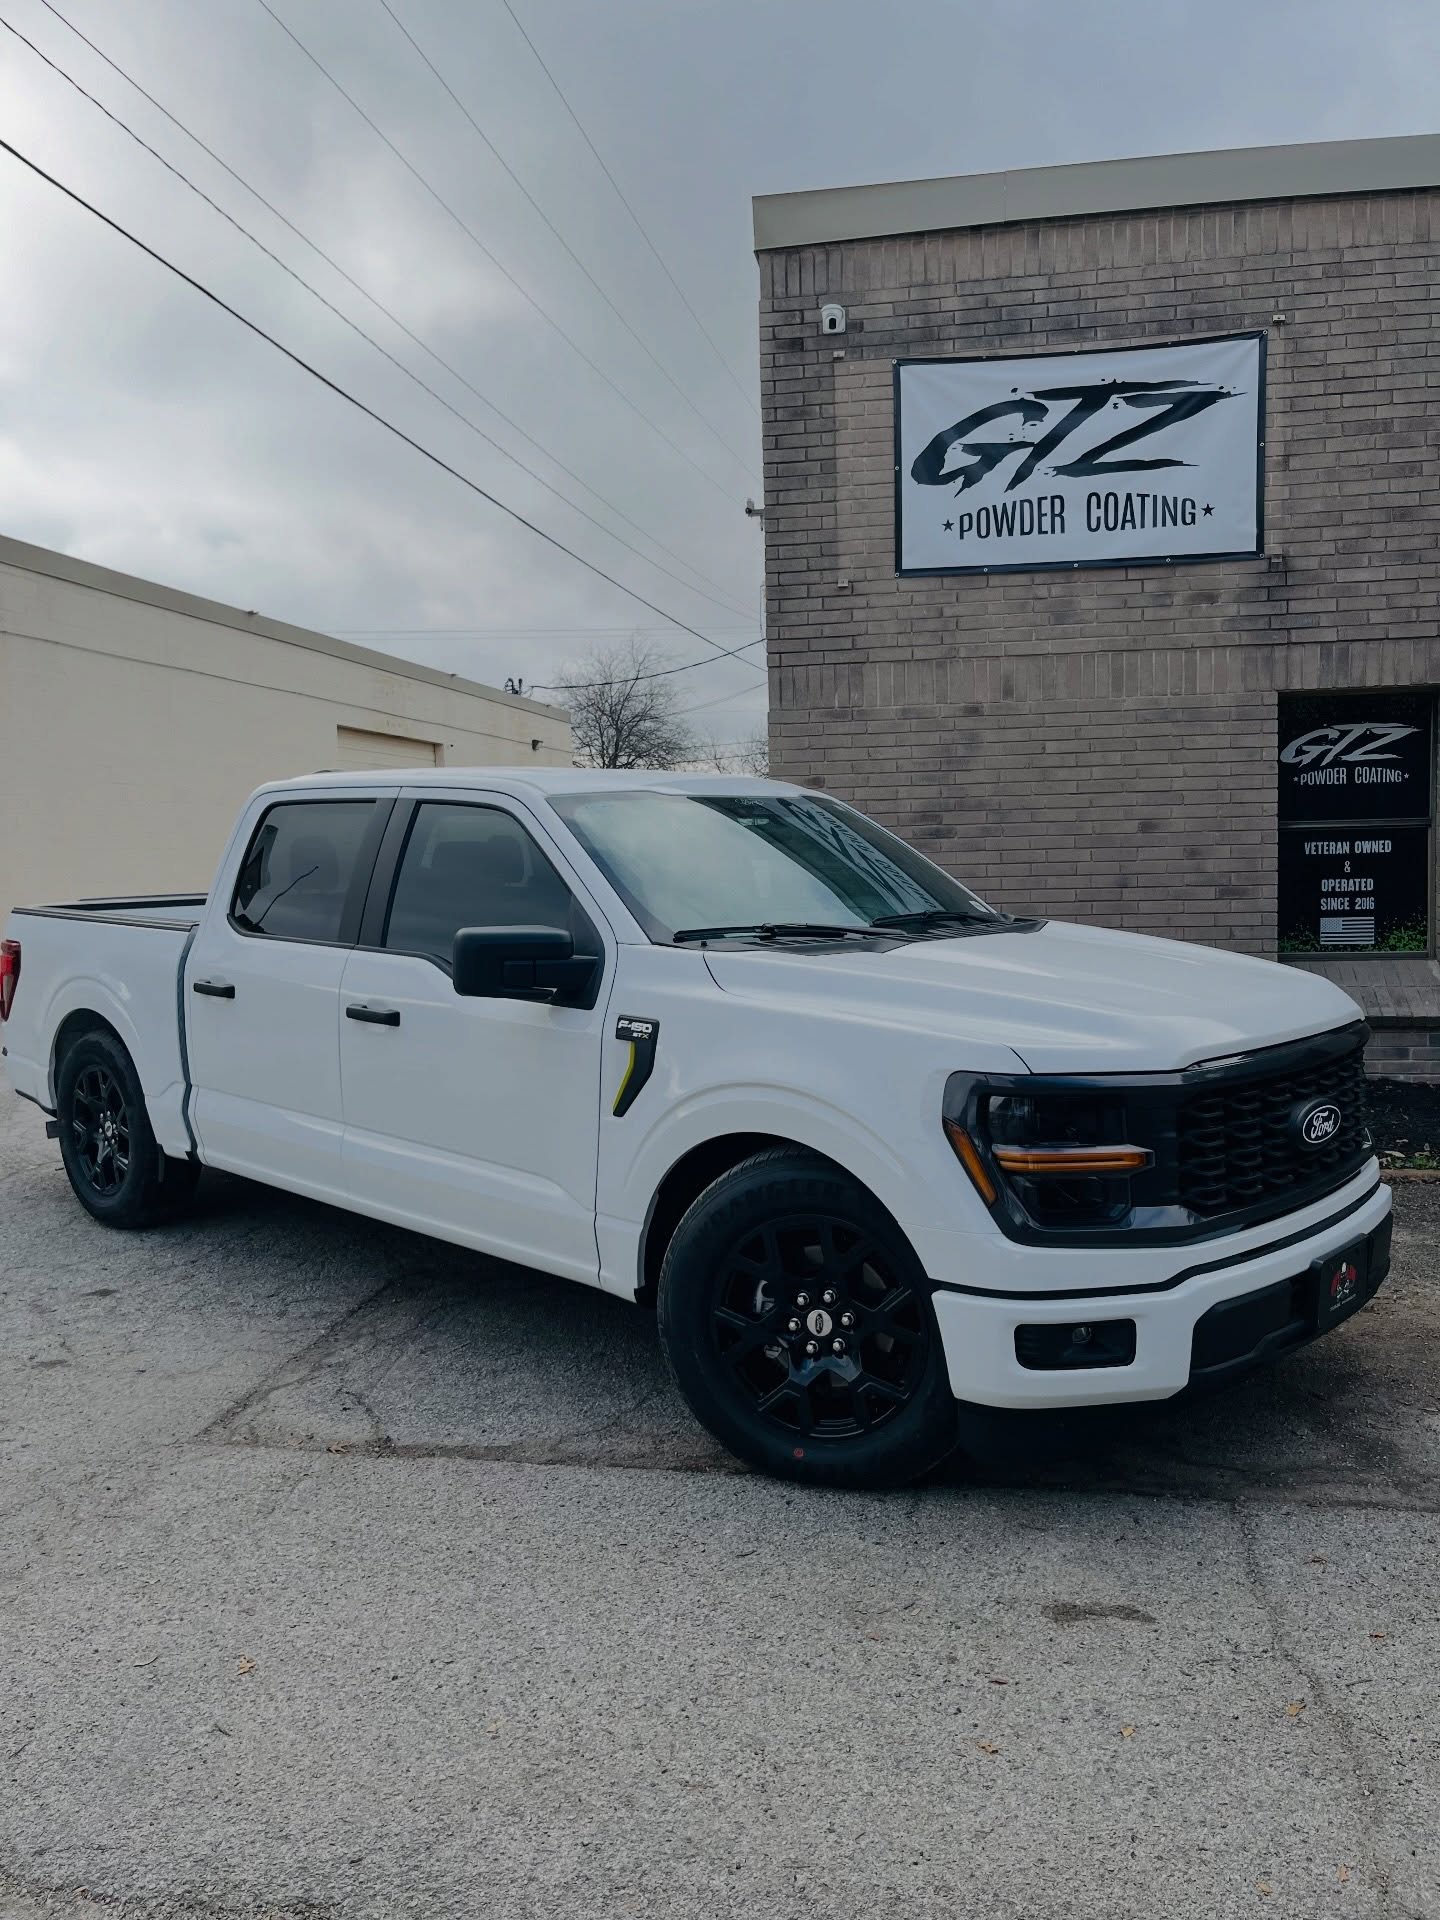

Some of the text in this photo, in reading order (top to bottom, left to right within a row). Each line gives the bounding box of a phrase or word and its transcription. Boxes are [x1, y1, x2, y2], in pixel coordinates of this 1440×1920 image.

[911, 379, 1247, 498] GTZ
[959, 491, 1197, 540] POWDER COATING
[1280, 722, 1424, 768] GTZ
[1300, 766, 1402, 786] POWDER COATING
[1304, 840, 1392, 855] VETERAN OWNED
[1344, 860, 1351, 873] &
[1321, 878, 1374, 892] OPERATED
[1320, 896, 1375, 911] SINCE 2016
[1310, 1110, 1335, 1139] Ford
